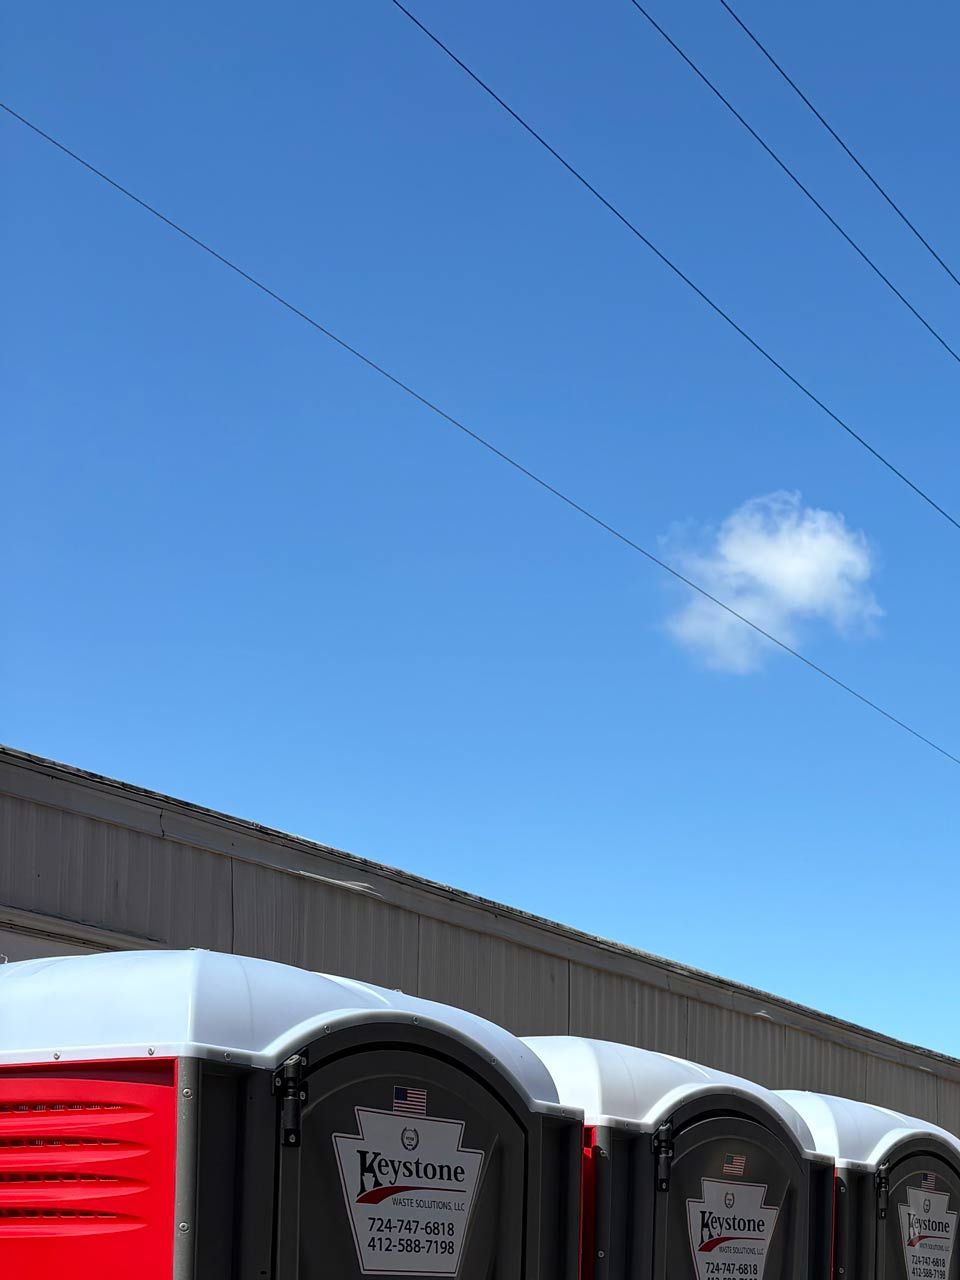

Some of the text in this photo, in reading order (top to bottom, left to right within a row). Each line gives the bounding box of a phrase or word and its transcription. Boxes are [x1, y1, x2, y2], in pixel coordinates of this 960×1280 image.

[357, 1150, 465, 1197] Keystone
[391, 1197, 414, 1208] WASTE
[453, 1202, 465, 1212] LLC
[368, 1217, 454, 1236] 724-747-6818
[699, 1210, 765, 1247] Keystone
[907, 1212, 950, 1241] Keystone
[367, 1237, 454, 1255] 412-588-7198
[705, 1262, 758, 1275] 724-747-6818
[911, 1255, 945, 1268] 724-747-6818
[911, 1267, 946, 1280] 412-588-7198
